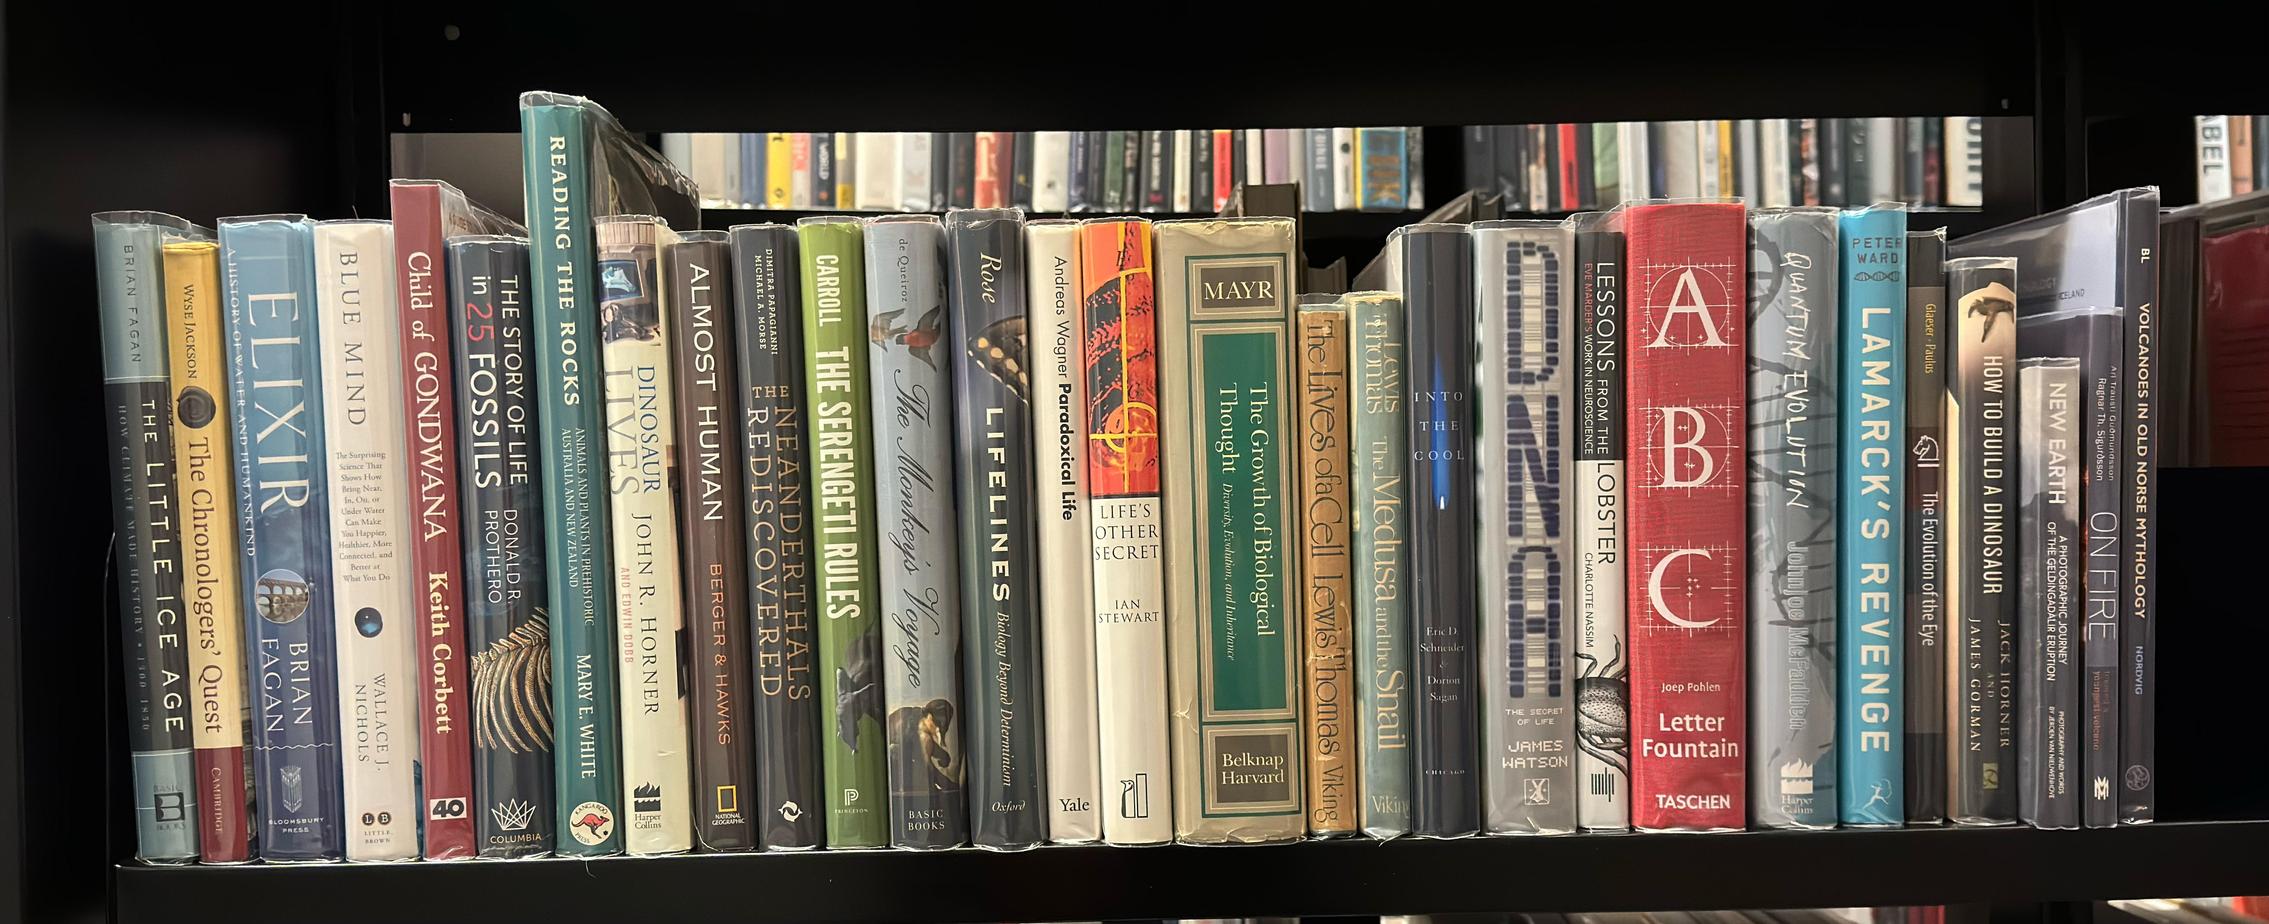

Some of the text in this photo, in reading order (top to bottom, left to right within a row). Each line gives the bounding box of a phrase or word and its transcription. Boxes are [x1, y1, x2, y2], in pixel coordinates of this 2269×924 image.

[2202, 116, 2223, 175] BEL
[550, 136, 579, 406] READING THE ROCKS
[815, 254, 841, 327] CARROLL
[899, 238, 908, 252] de
[980, 251, 1002, 304] Rose
[1204, 281, 1274, 300] MAYR
[1858, 253, 1898, 263] WARD
[2141, 248, 2150, 264] BL
[123, 245, 141, 363] BRIAN FAGAN
[183, 284, 197, 379] WYSE JACKSON
[340, 251, 367, 426] BLUE MIND
[755, 254, 767, 350] MICHAEL MORSE
[768, 293, 777, 355] PAPAGIANNI
[1780, 252, 1812, 361] QUANTUM
[1925, 304, 1937, 375] Glaeser Paulus
[248, 292, 310, 513] ELIXIR
[407, 251, 448, 542] Child of GONDWANA
[466, 276, 502, 489] in 25 FOSSILS
[500, 275, 528, 485] THE STORY OF LIFE
[689, 263, 723, 521] ALMOST HUMAN
[752, 385, 789, 399] THE
[1050, 256, 1077, 521] Andreas Wagner Paradoxical Life
[1415, 391, 1464, 402] INTO
[1584, 284, 1593, 455] MARDER'S WORK NEUROSCIENCE
[1596, 262, 1616, 564] LESSONS FROM THE LOBSTER
[638, 366, 661, 494] DINOSAUR
[1215, 382, 1240, 475] Thought
[1307, 319, 1345, 559] The Lives Cell
[1414, 450, 1465, 461] COOL
[1420, 421, 1459, 431] THE
[2048, 383, 2067, 504] NEW EARTH
[2133, 303, 2150, 620] VOLCANOES OLD NORSE MYTHOLOGY
[815, 346, 861, 619] THE SERENGETI RULES
[1100, 504, 1151, 519] LIFE'S
[1250, 381, 1275, 636] The Growth Biological
[1983, 356, 2003, 595] HOW TO BUILD DINOSAUR
[141, 400, 184, 733] THE LITTLE ICE AGE
[485, 510, 502, 604] PROTHERO
[504, 510, 520, 583] DONALD
[580, 504, 594, 626] PLANTS PREHISTORIC
[747, 407, 782, 696] REDISCOVERED
[774, 406, 811, 700] NEANDERTHALS
[891, 367, 940, 689] The Voyage
[1095, 525, 1158, 539] OTHER
[1095, 545, 1159, 560] SECRET
[1860, 307, 1892, 752] LAMARCK'S REVENGE
[188, 437, 223, 733] The Chronologers' Quest
[632, 514, 660, 715] JOHN HORNER
[985, 408, 1015, 786] LIFELINES Biology Beyond Determinism
[1098, 612, 1159, 623] STEWART
[1115, 600, 1140, 610] IAN
[1373, 472, 1407, 751] Medusa Snail
[1584, 552, 1594, 648] CHARLOTTE NASSIM
[1918, 517, 1938, 647] Evolution Eye
[2058, 545, 2068, 618] PHOTOGRAPHIC
[2087, 511, 2117, 641] ON FIRE
[262, 638, 285, 732] FAGAN
[289, 642, 312, 726] BRIAN
[428, 571, 454, 735] Keith Corbett
[710, 563, 731, 745] BERGER HAWKS
[1313, 575, 1347, 756] Lewis Thomas
[1420, 643, 1464, 652] Schneider
[1427, 676, 1460, 685] Dorion
[1687, 682, 1721, 692] Pohlen
[1788, 627, 1810, 730] McFadden
[1970, 618, 1982, 753] JAMES GORMAN
[2134, 645, 2145, 696] NORDVIG
[355, 685, 370, 762] NICHOLS
[373, 673, 389, 755] WALLACE
[577, 654, 596, 779] MARY WHITE
[1430, 692, 1458, 703] Sagan
[1660, 713, 1725, 732] Letter
[1999, 671, 2010, 749] HORNER
[1222, 753, 1284, 770] Belknap
[1222, 770, 1284, 784] Harvard
[1503, 756, 1568, 768] WATSON
[1508, 741, 1563, 752] JAMES
[1643, 739, 1739, 758] Fountain
[490, 833, 542, 844] COLUMBIA
[908, 809, 944, 820] BASIC
[908, 821, 945, 831] BOOKS
[1060, 798, 1090, 812] Yale
[1314, 765, 1344, 823] Viking
[1656, 794, 1731, 809] TASCHEN
